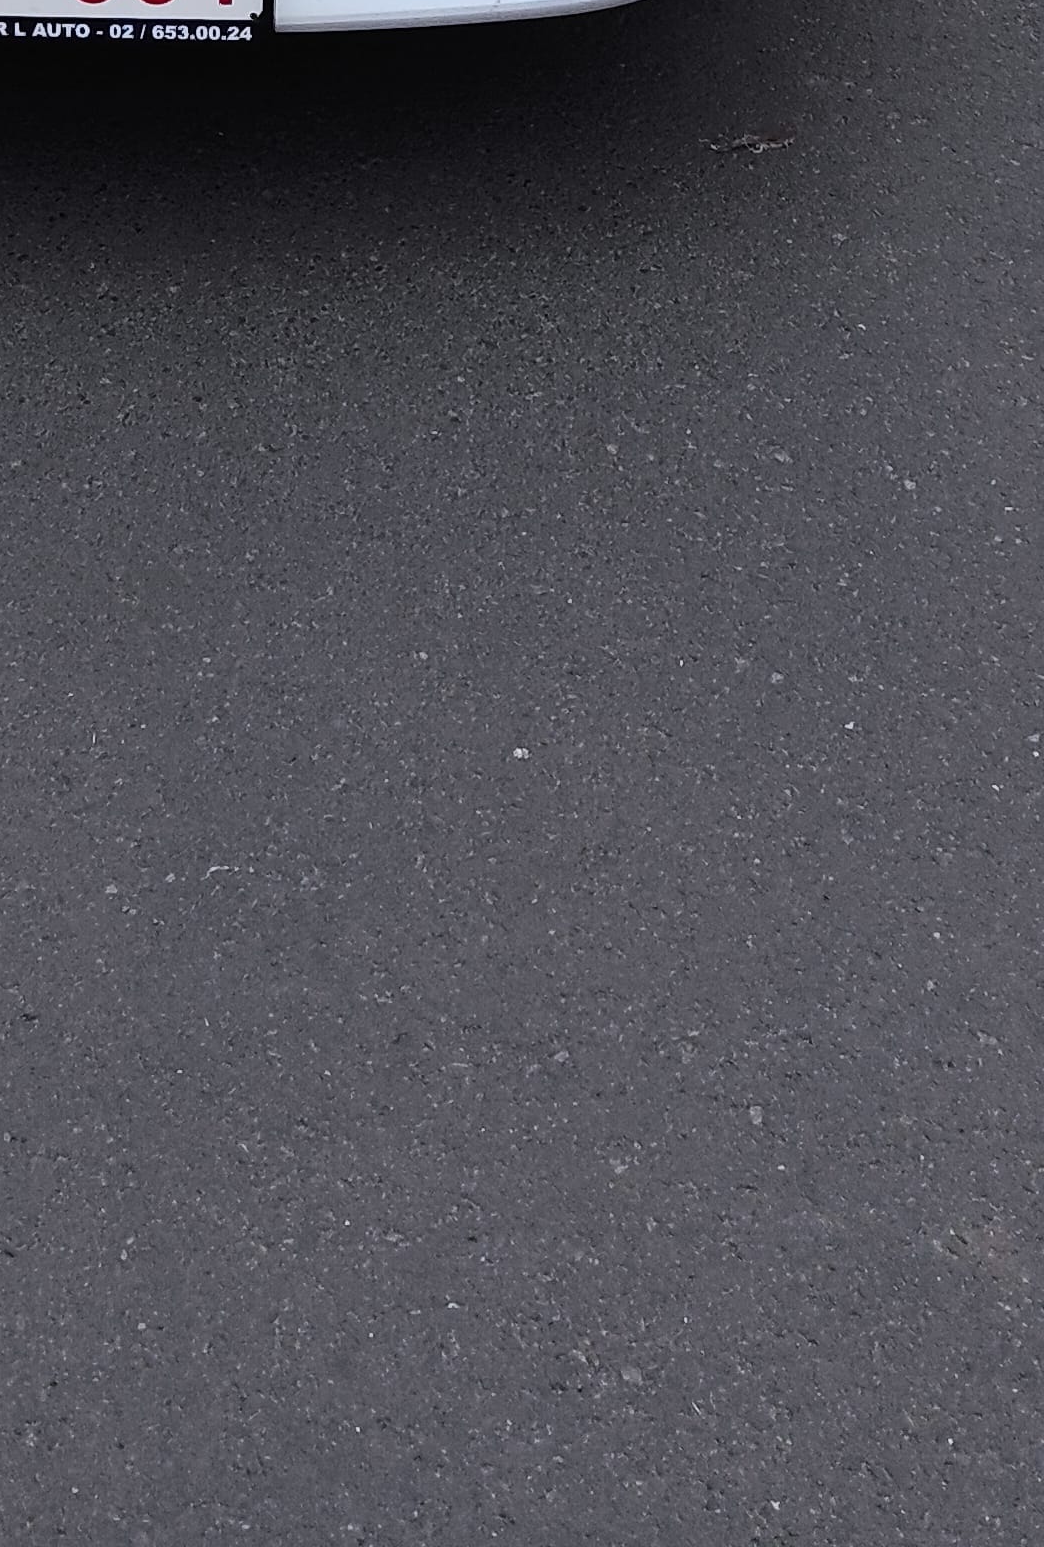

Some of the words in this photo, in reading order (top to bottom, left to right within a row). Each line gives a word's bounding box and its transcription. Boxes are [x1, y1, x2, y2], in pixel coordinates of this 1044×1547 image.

[14, 20, 27, 37] L
[31, 21, 91, 39] AUTO
[108, 23, 135, 39] 02
[139, 23, 146, 39] /
[151, 24, 253, 41] 653.00.24
